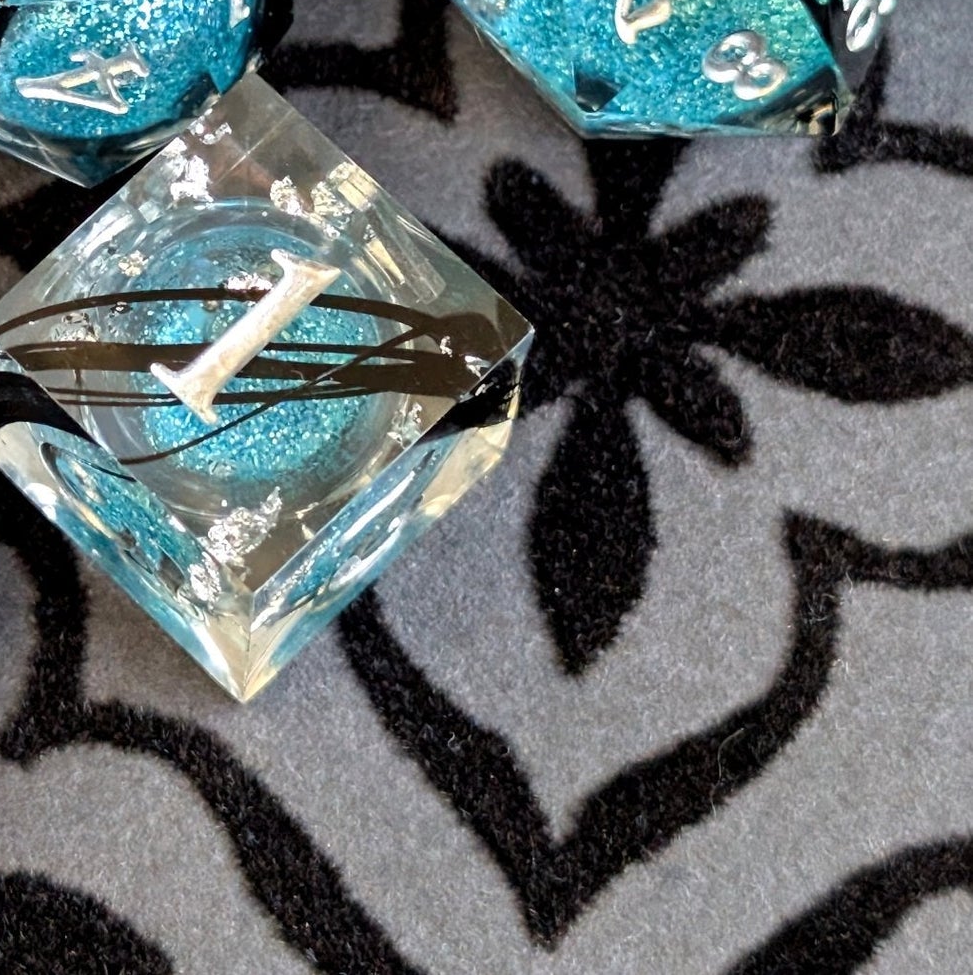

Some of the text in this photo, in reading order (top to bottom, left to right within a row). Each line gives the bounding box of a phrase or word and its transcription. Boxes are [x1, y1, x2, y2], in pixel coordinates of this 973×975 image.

[14, 41, 151, 116] 4
[702, 28, 789, 102] 8
[149, 247, 342, 426] 1
